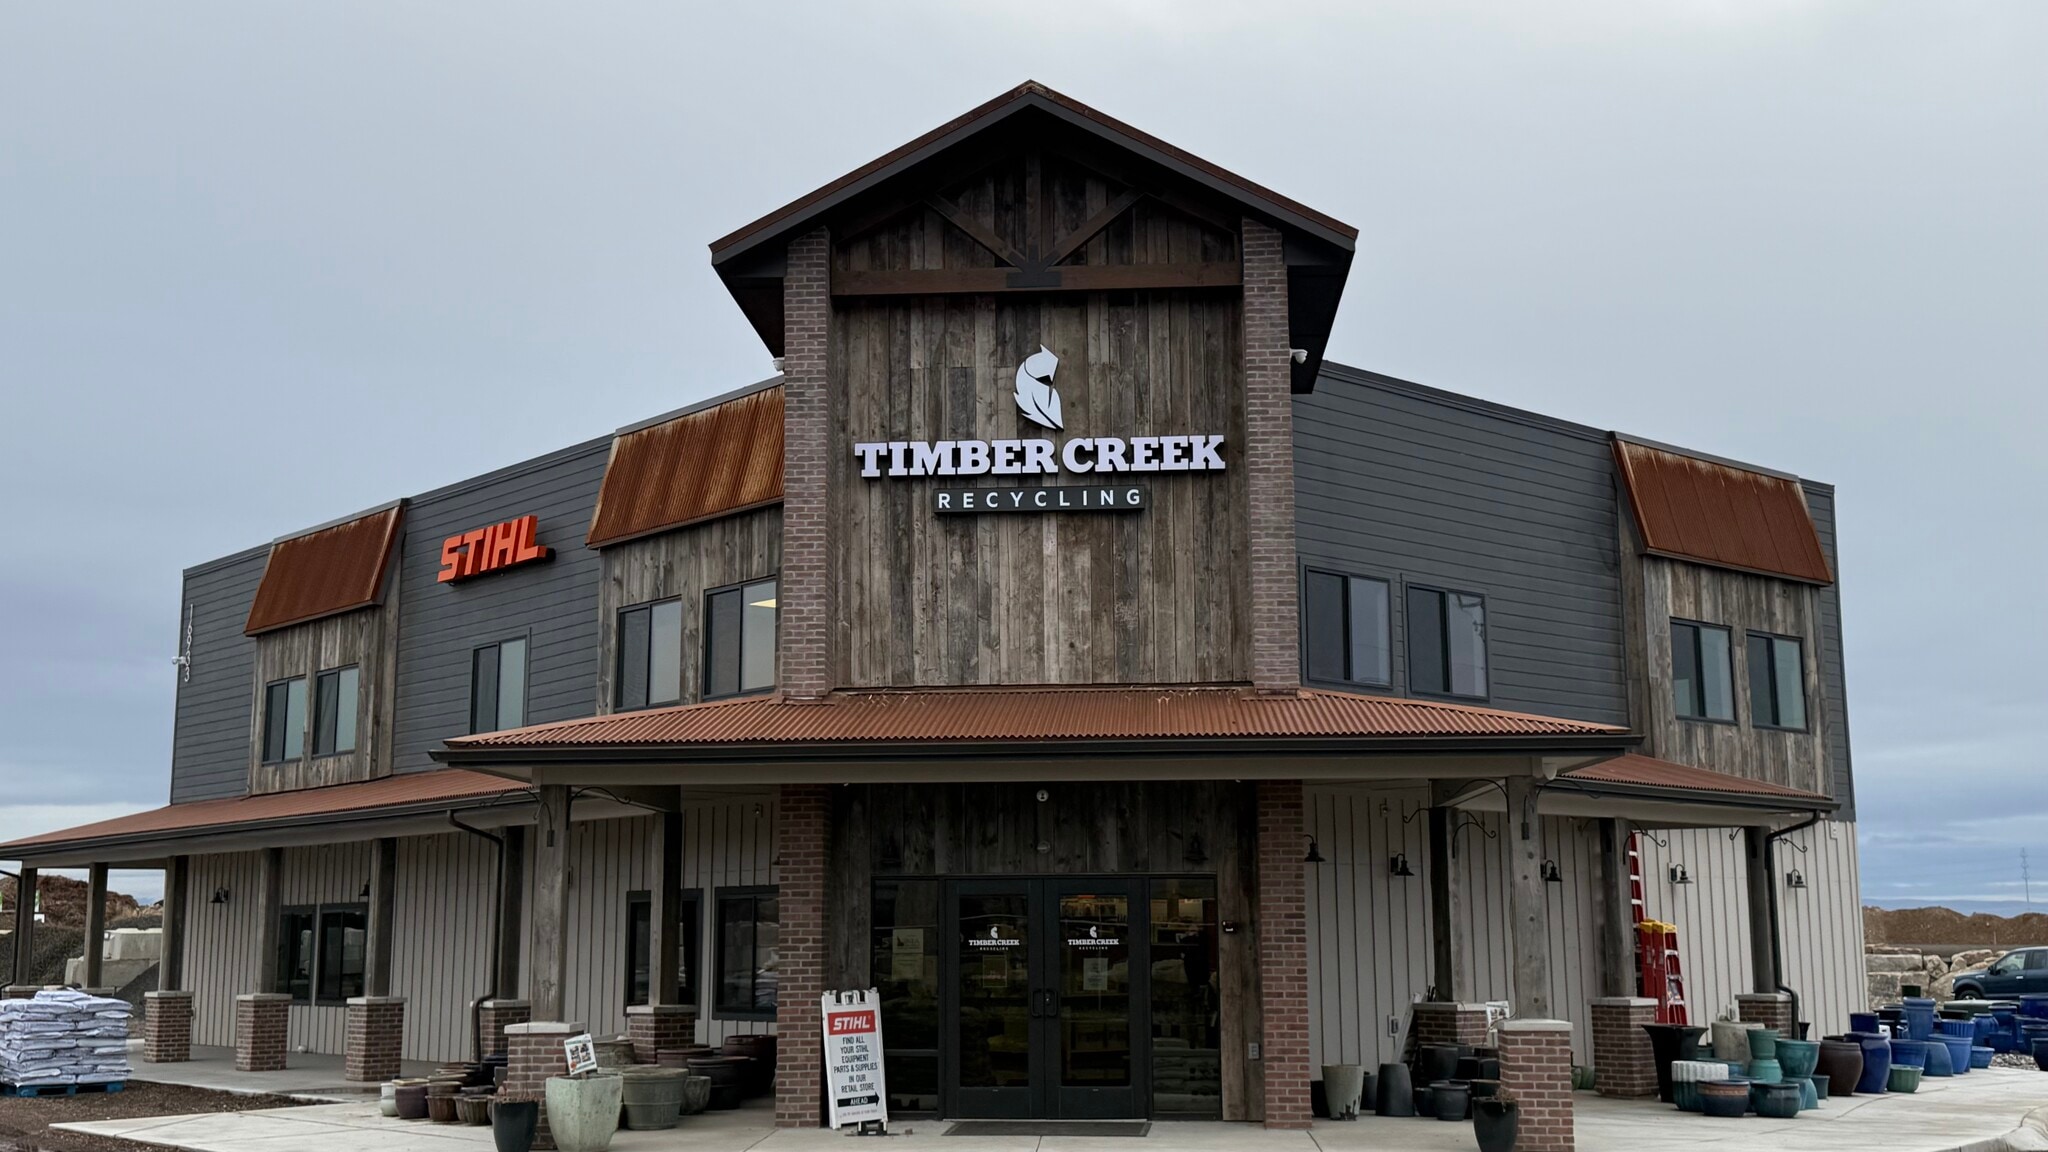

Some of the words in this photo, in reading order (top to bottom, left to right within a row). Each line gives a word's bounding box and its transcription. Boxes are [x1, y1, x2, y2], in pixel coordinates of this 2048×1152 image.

[855, 439, 1059, 477] TIMBER
[1061, 435, 1226, 473] CREEK
[938, 488, 1141, 509] RECYCLING
[437, 515, 547, 583] STIHL
[184, 603, 193, 682] 16933
[1067, 938, 1096, 946] TIMBER
[1095, 938, 1119, 946] CREEK
[832, 1015, 871, 1031] STIHL
[842, 1036, 854, 1045] FIND
[855, 1035, 865, 1044] ALL
[840, 1046, 854, 1055] YOUR
[855, 1045, 869, 1053] STIHL
[841, 1054, 869, 1064] EQUIPMENT
[834, 1064, 849, 1074] PARTS
[850, 1064, 855, 1073] &
[855, 1062, 878, 1072] SUPPLIES
[848, 1075, 855, 1083] IN
[855, 1074, 867, 1082] OUR
[841, 1084, 858, 1093] RETAIL
[860, 1082, 875, 1091] STORE
[850, 1097, 869, 1106] AHEAD
